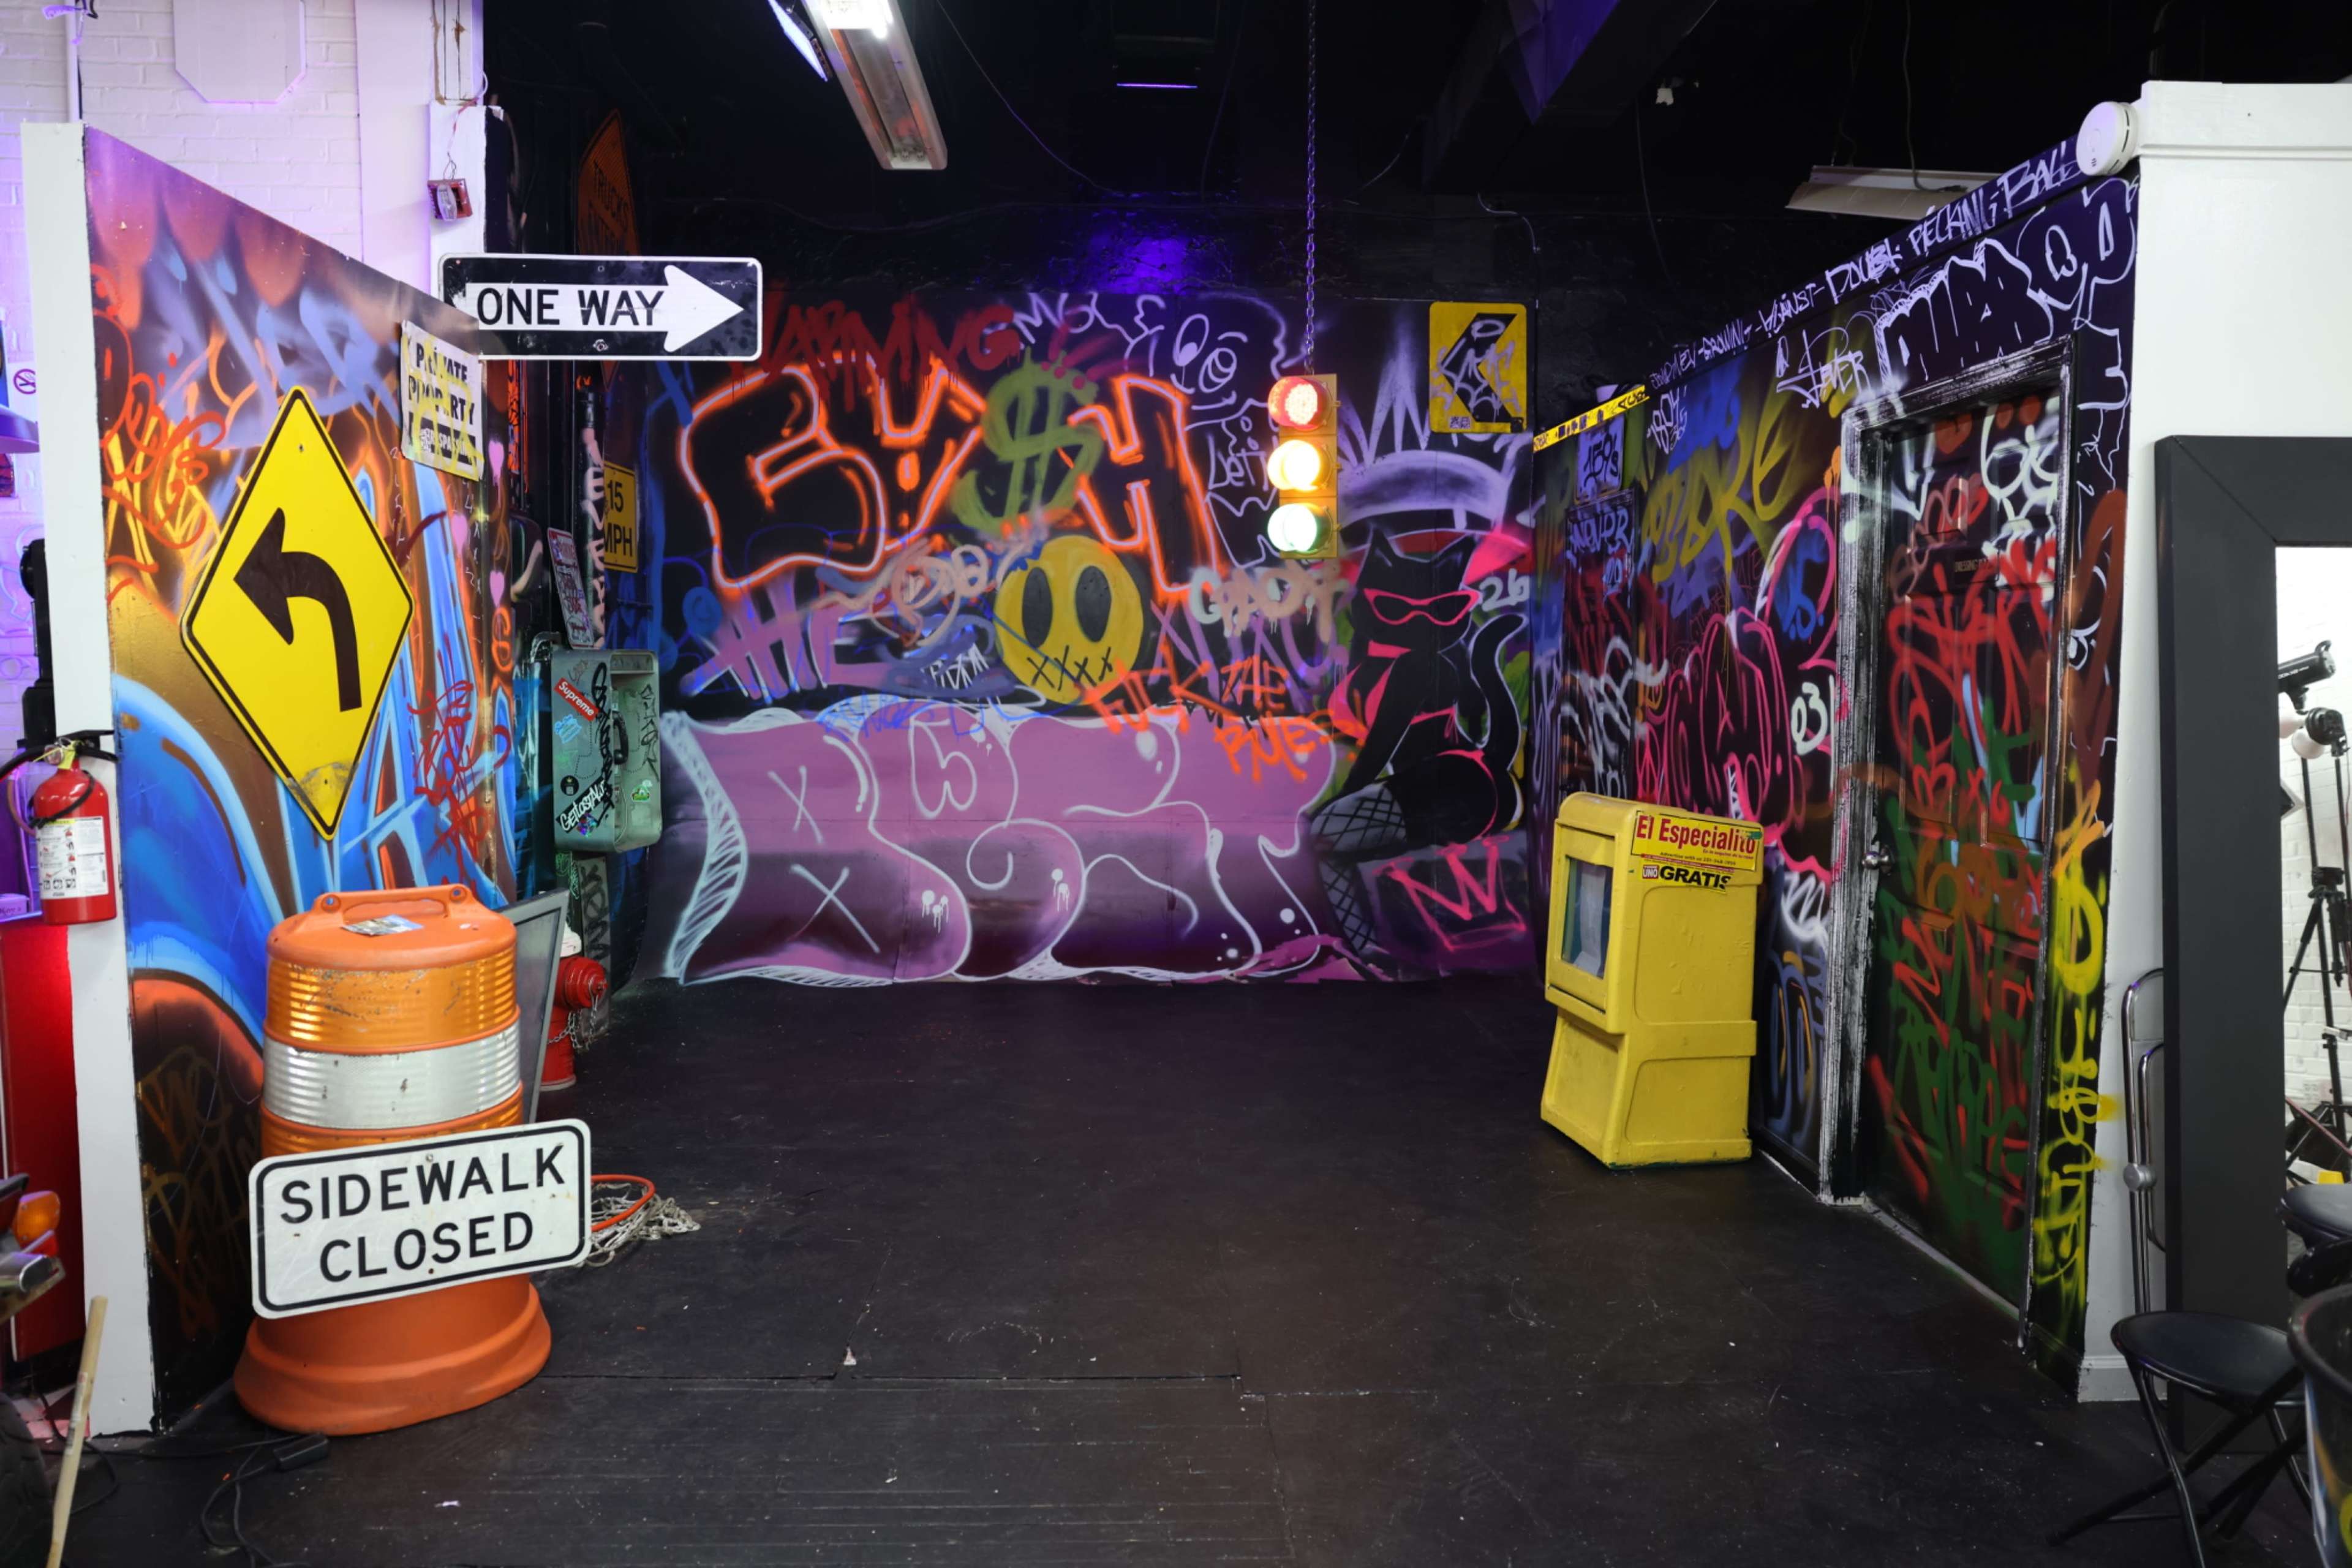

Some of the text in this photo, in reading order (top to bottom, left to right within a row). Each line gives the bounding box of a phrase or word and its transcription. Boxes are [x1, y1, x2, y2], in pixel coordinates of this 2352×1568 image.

[476, 287, 665, 326] ONE WAY
[607, 480, 624, 513] 15
[558, 680, 595, 717] Supreme
[1636, 815, 1756, 854] El Especialito
[1643, 865, 1732, 890] UNO GRATIS
[280, 1142, 565, 1224] SIDEWALK
[319, 1210, 533, 1283] CLOSED
